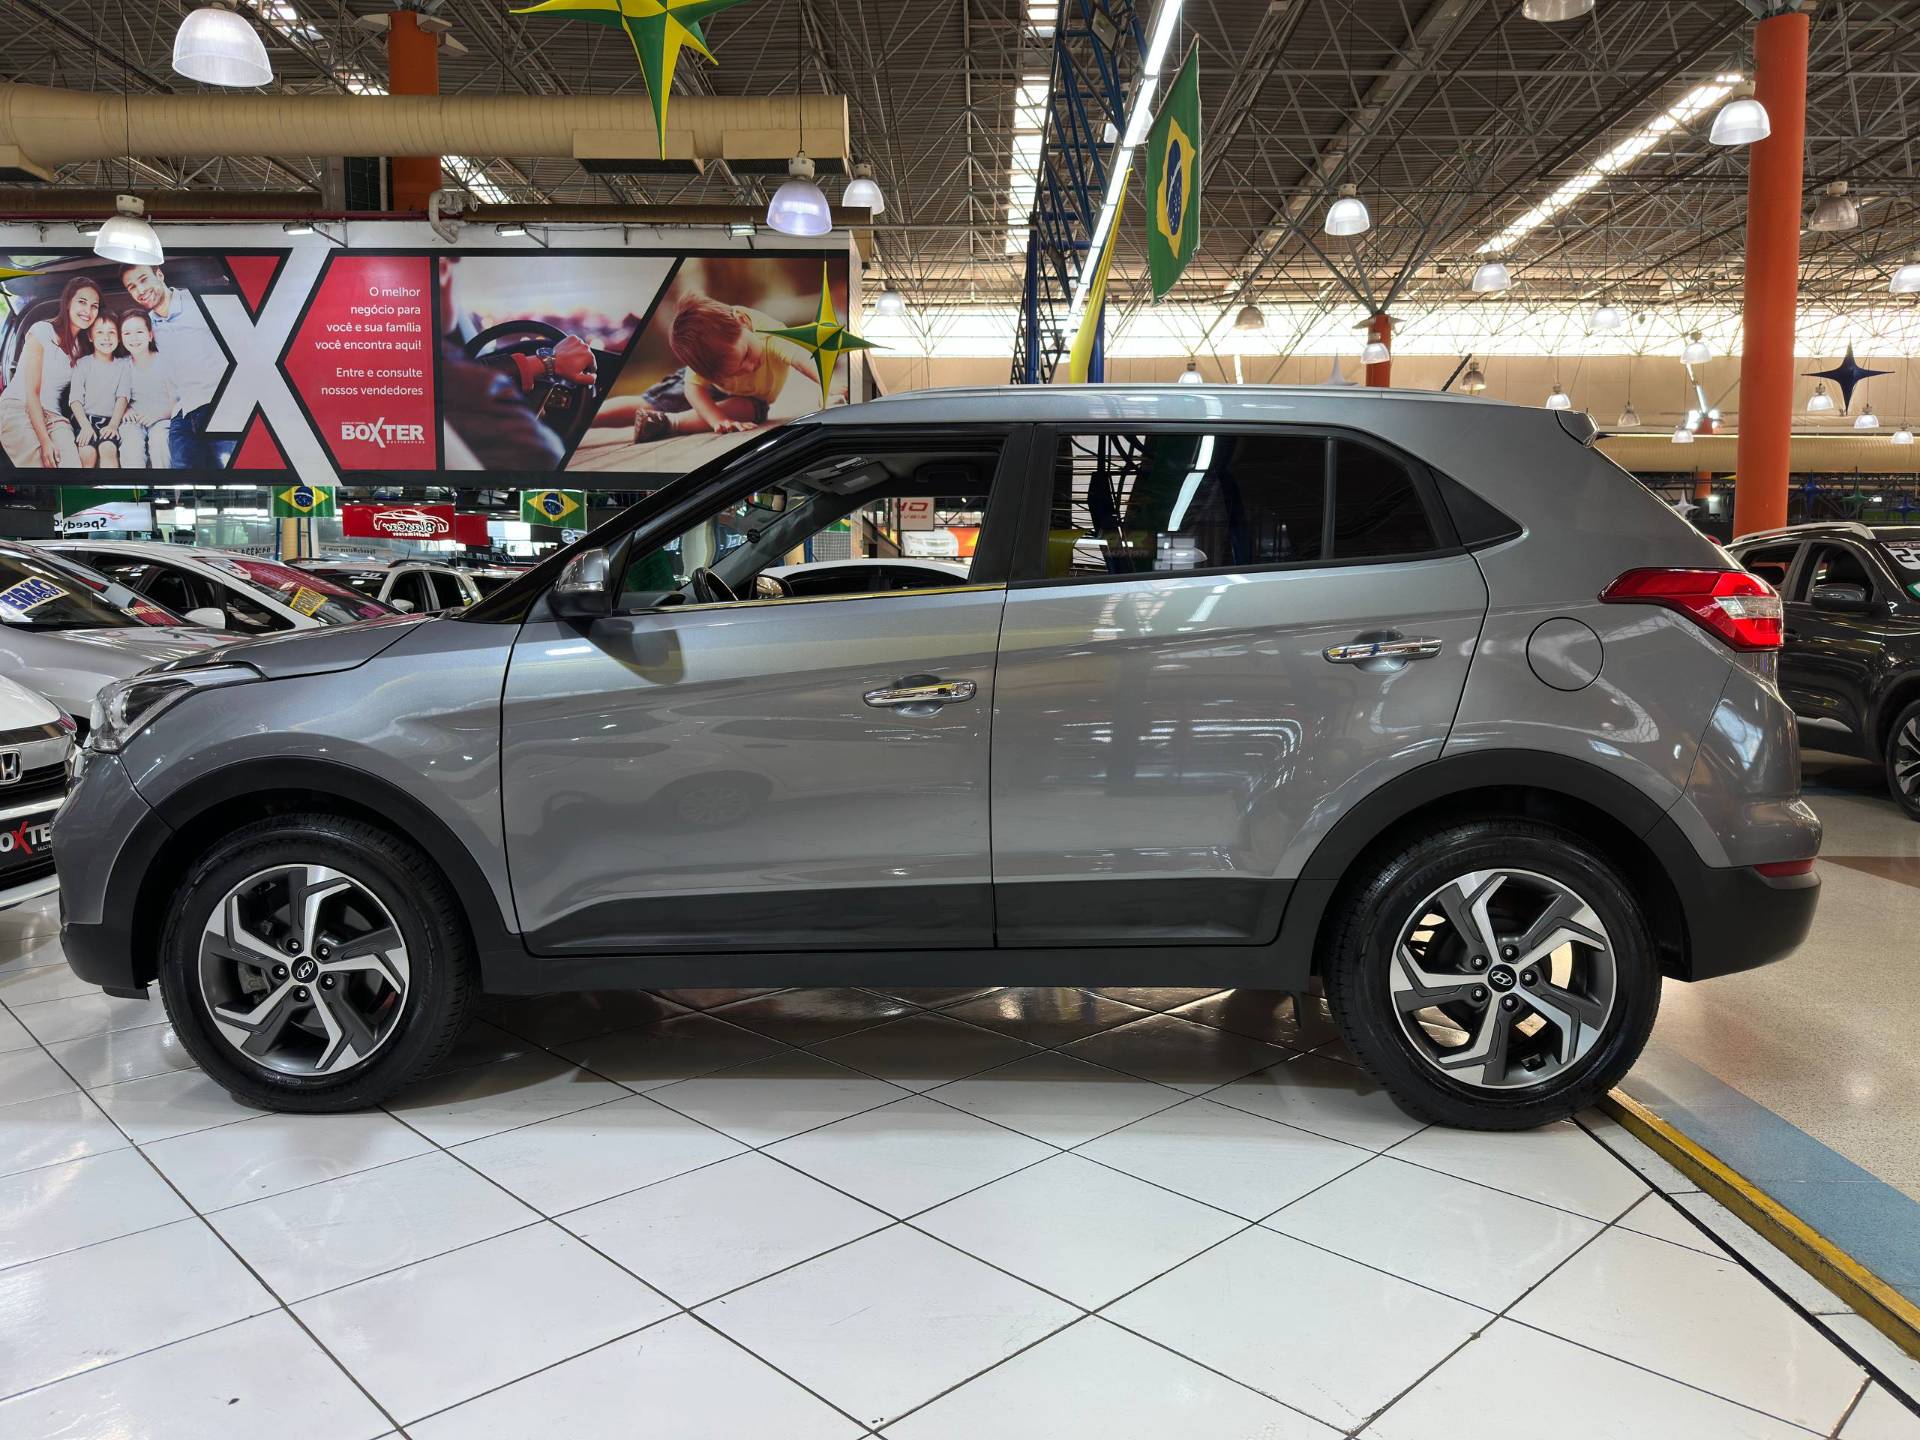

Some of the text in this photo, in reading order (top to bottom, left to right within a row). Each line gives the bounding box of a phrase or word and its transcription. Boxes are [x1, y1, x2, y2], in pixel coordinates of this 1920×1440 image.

[369, 286, 421, 297] O melhor
[350, 304, 421, 317] negócio para
[326, 322, 422, 333] você e sua família
[315, 339, 422, 352] você encontra aqui!
[336, 367, 423, 378] Entre e consulte
[321, 384, 424, 396] nossos vendedores
[341, 416, 425, 449] BOXTER
